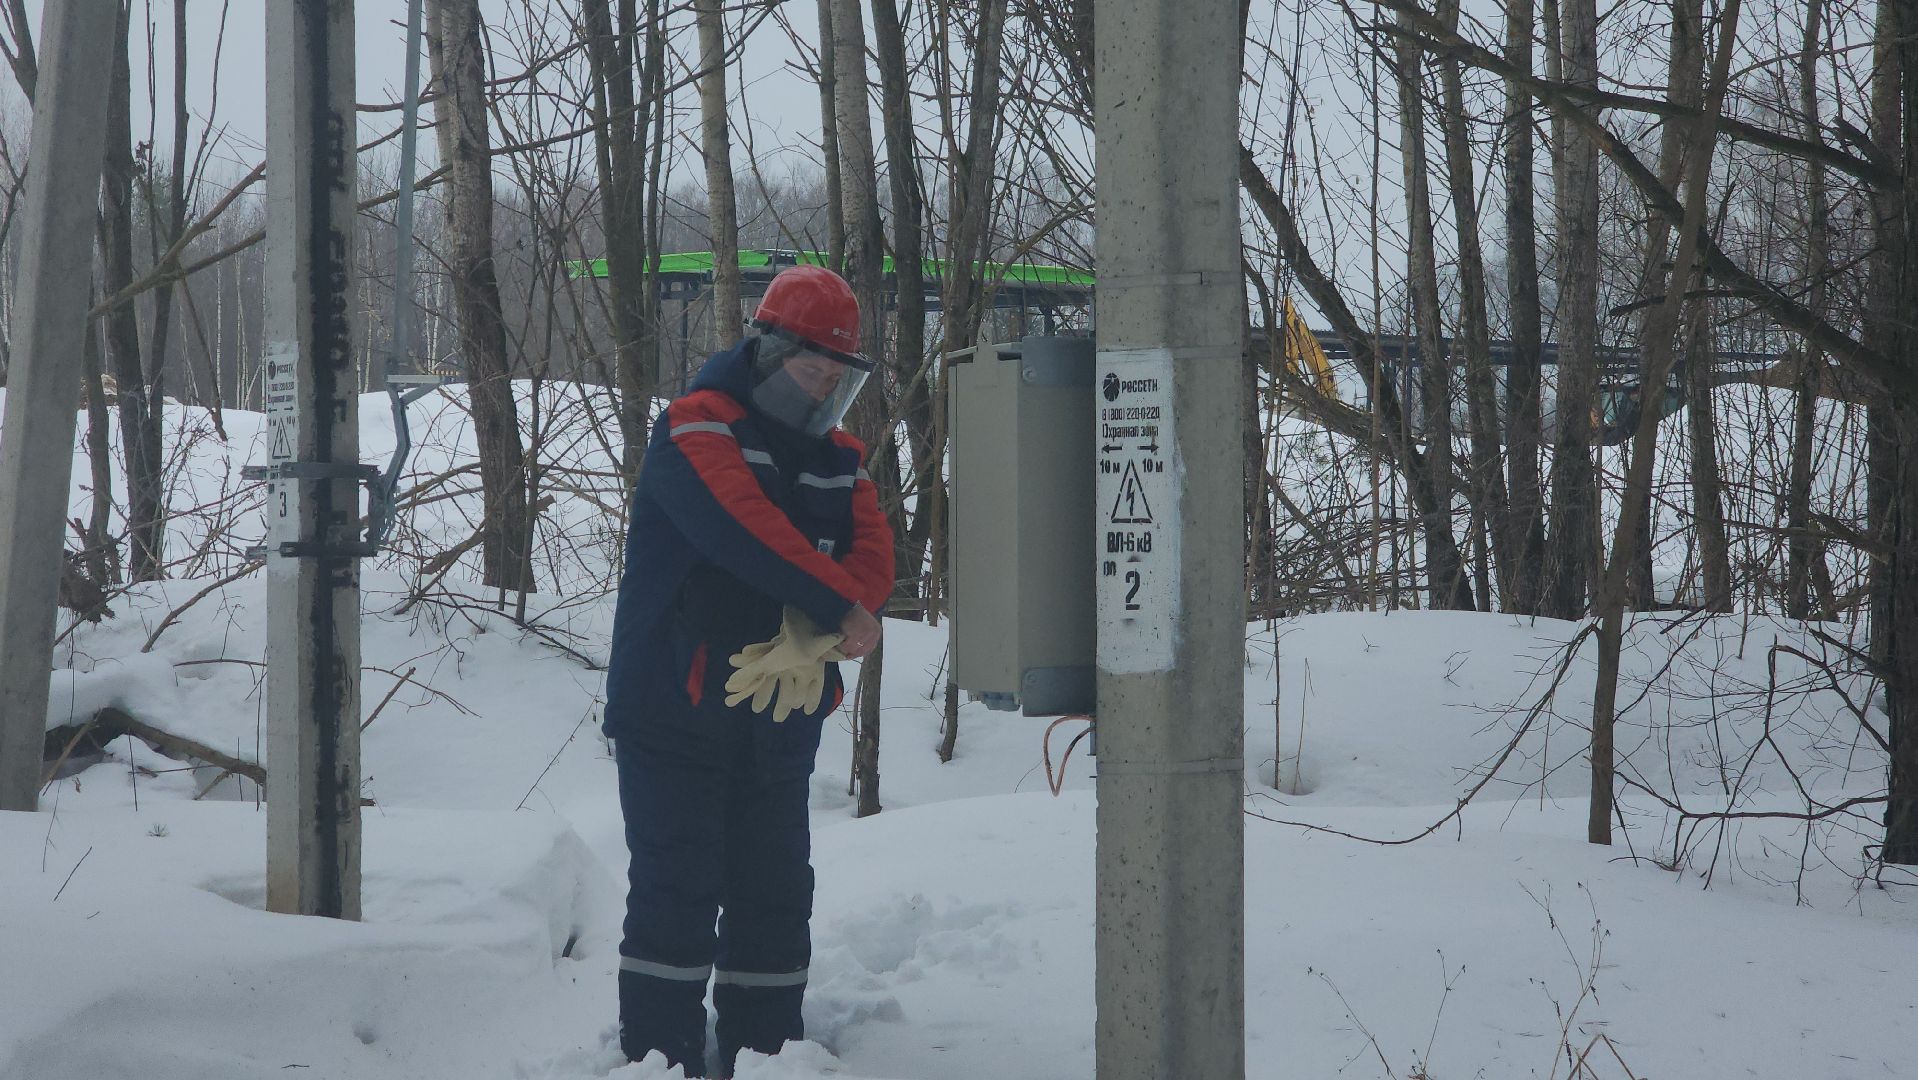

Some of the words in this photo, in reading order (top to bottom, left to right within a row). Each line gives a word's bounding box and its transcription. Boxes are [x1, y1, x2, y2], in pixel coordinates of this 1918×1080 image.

[1121, 379, 1158, 393] РОССЕТИ
[1099, 459, 1111, 474] 10
[1142, 458, 1153, 473] 10
[279, 491, 287, 518] 3
[1125, 570, 1140, 611] 2
